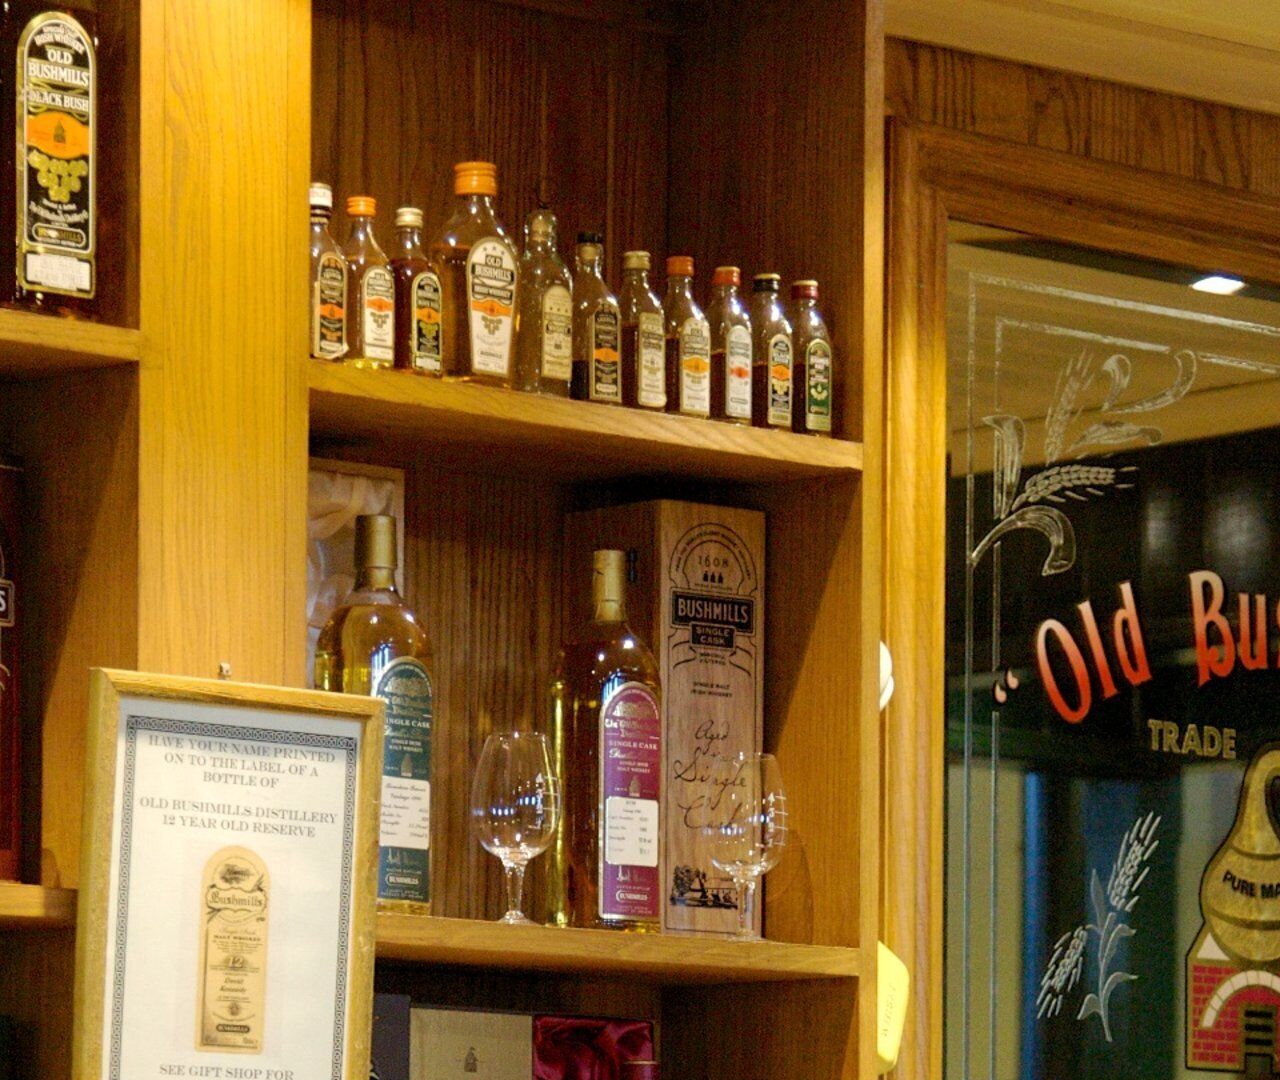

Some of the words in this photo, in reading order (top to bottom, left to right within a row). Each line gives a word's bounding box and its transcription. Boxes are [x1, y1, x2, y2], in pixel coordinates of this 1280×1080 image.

[47, 50, 72, 66] OLD
[27, 63, 90, 88] BUSHMILLS
[30, 87, 63, 107] BLACK
[63, 94, 90, 113] BUSH
[486, 255, 502, 266] OLD
[476, 264, 513, 281] BUSHMILLS
[697, 553, 730, 568] 1608
[677, 598, 750, 624] BUSHMILLS
[694, 625, 730, 638] SINGLE
[699, 634, 726, 647] CASK
[411, 719, 431, 730] CASK
[608, 739, 638, 749] SINGLE
[638, 742, 658, 751] CASK
[1147, 718, 1238, 760] TRADE
[149, 734, 184, 749] HAVE
[190, 738, 228, 753] YOUR
[231, 743, 270, 757] NAME
[273, 747, 336, 764] PRINTED
[163, 753, 184, 765] ON
[188, 754, 207, 767] TO
[210, 756, 238, 769] THE
[241, 759, 286, 775] LABEL
[288, 764, 308, 777] OF
[310, 767, 320, 778] A
[202, 771, 258, 788] BOTTLE
[260, 776, 280, 789] OF
[140, 796, 169, 809] OLD
[172, 799, 253, 818] BUSHMILLS
[255, 807, 338, 825] DISTILLERY
[162, 814, 176, 825] 12
[178, 815, 218, 829] YEAR
[220, 818, 250, 832] OLD
[252, 822, 317, 838] RESERVE
[1222, 869, 1257, 899] PURE
[209, 890, 263, 908] Bushmills
[228, 954, 246, 969] 12
[159, 1064, 186, 1077] SEE
[188, 1066, 223, 1079] GIFT
[224, 1068, 263, 1080] SHOP
